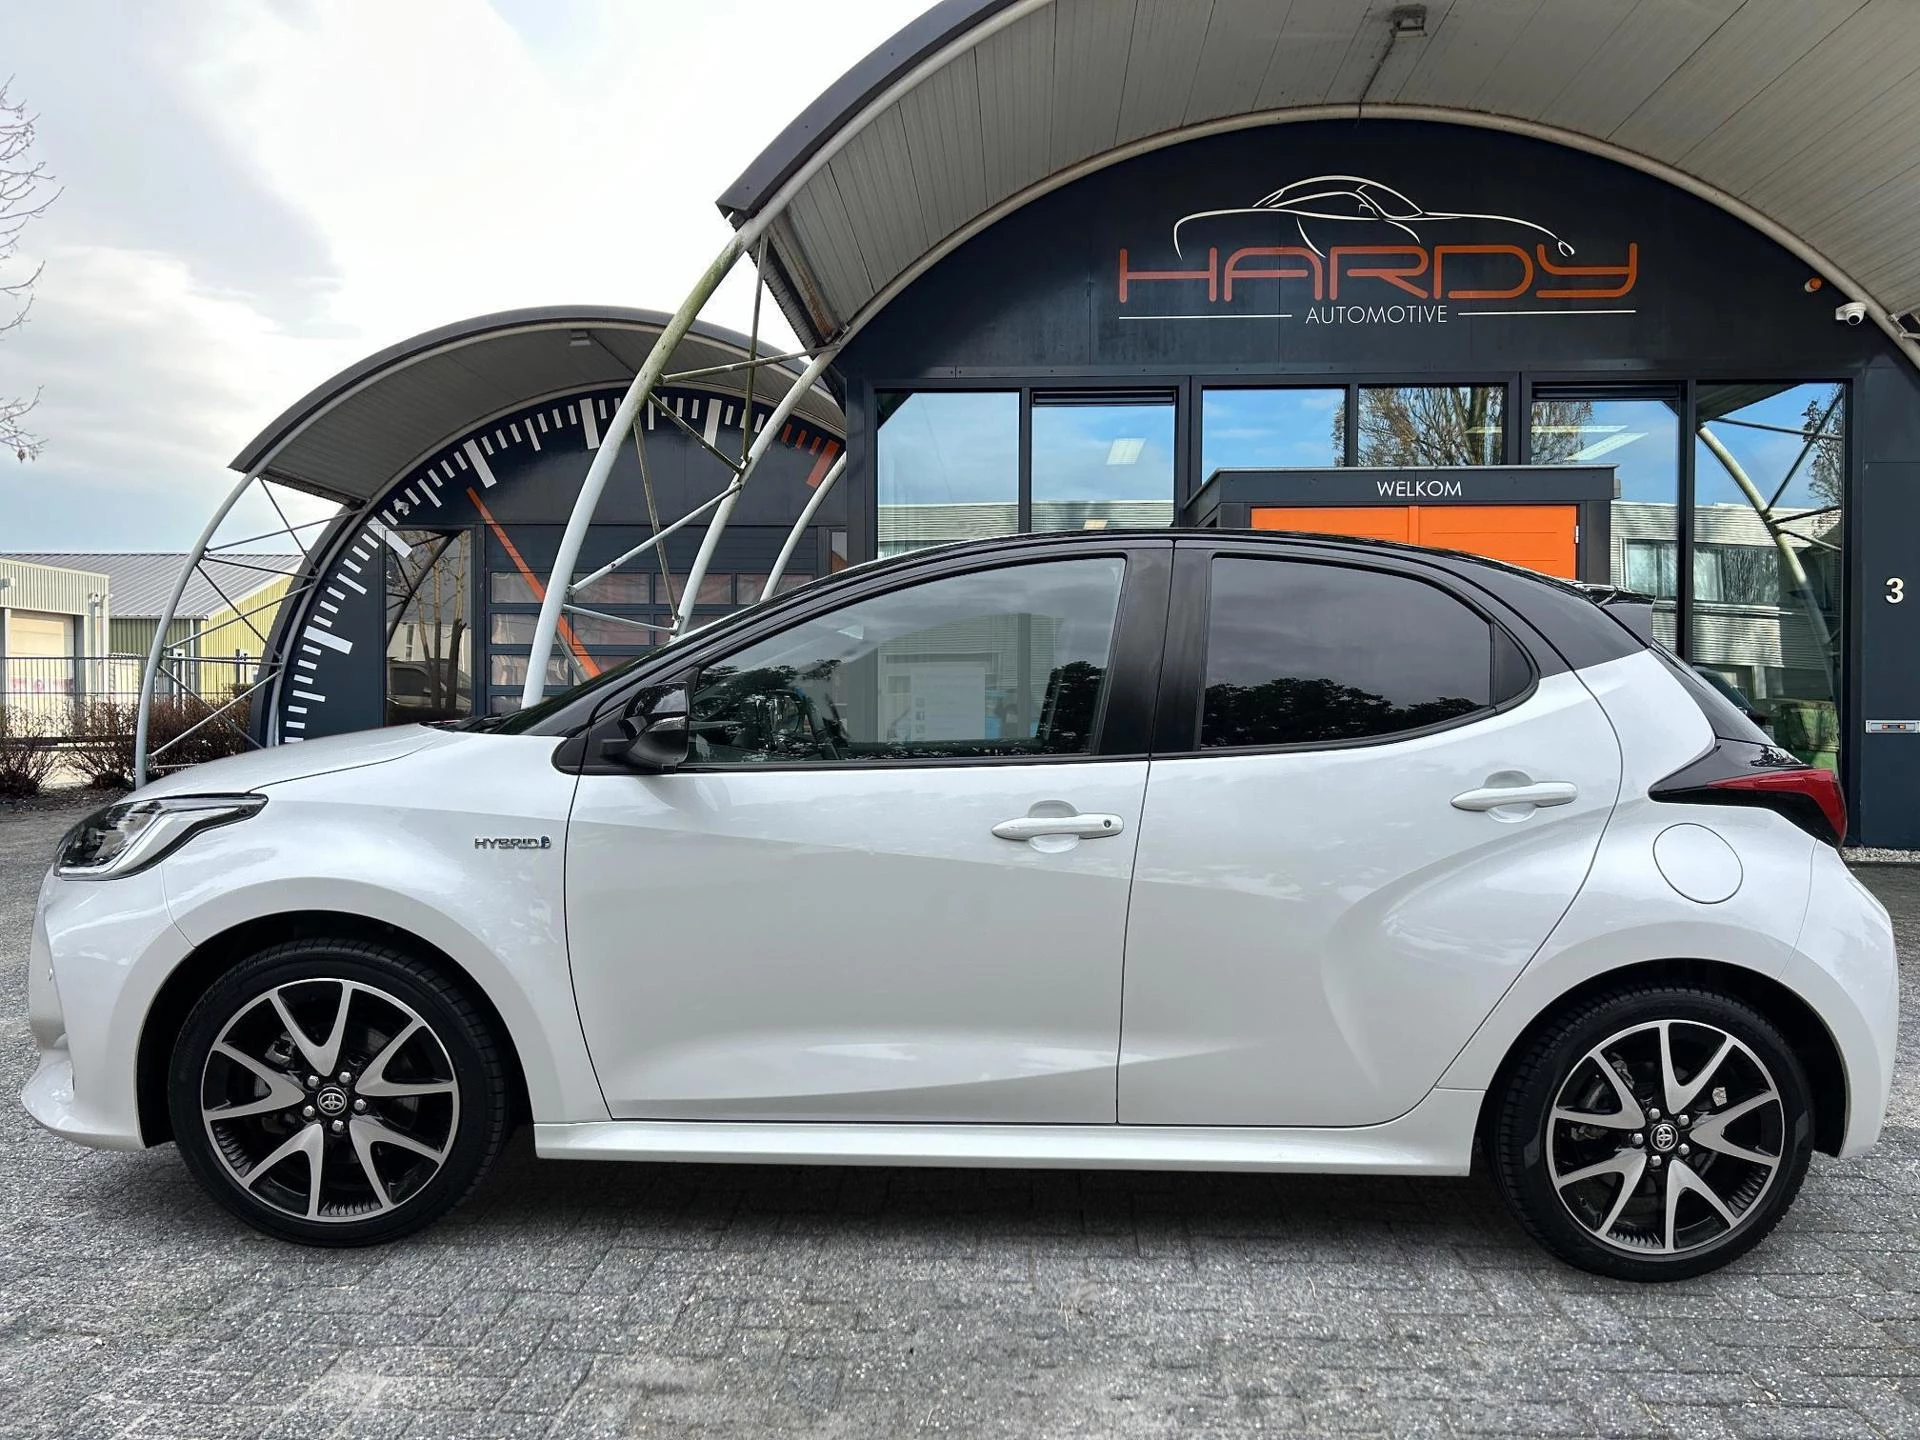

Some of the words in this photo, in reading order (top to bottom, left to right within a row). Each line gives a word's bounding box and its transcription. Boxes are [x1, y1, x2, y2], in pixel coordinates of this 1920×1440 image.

[1119, 243, 1638, 302] HARDY
[1305, 305, 1448, 325] AUTOMOTIVE
[1376, 480, 1462, 497] WELKOM
[1885, 577, 1904, 604] 3
[474, 837, 540, 849] HYBRID
